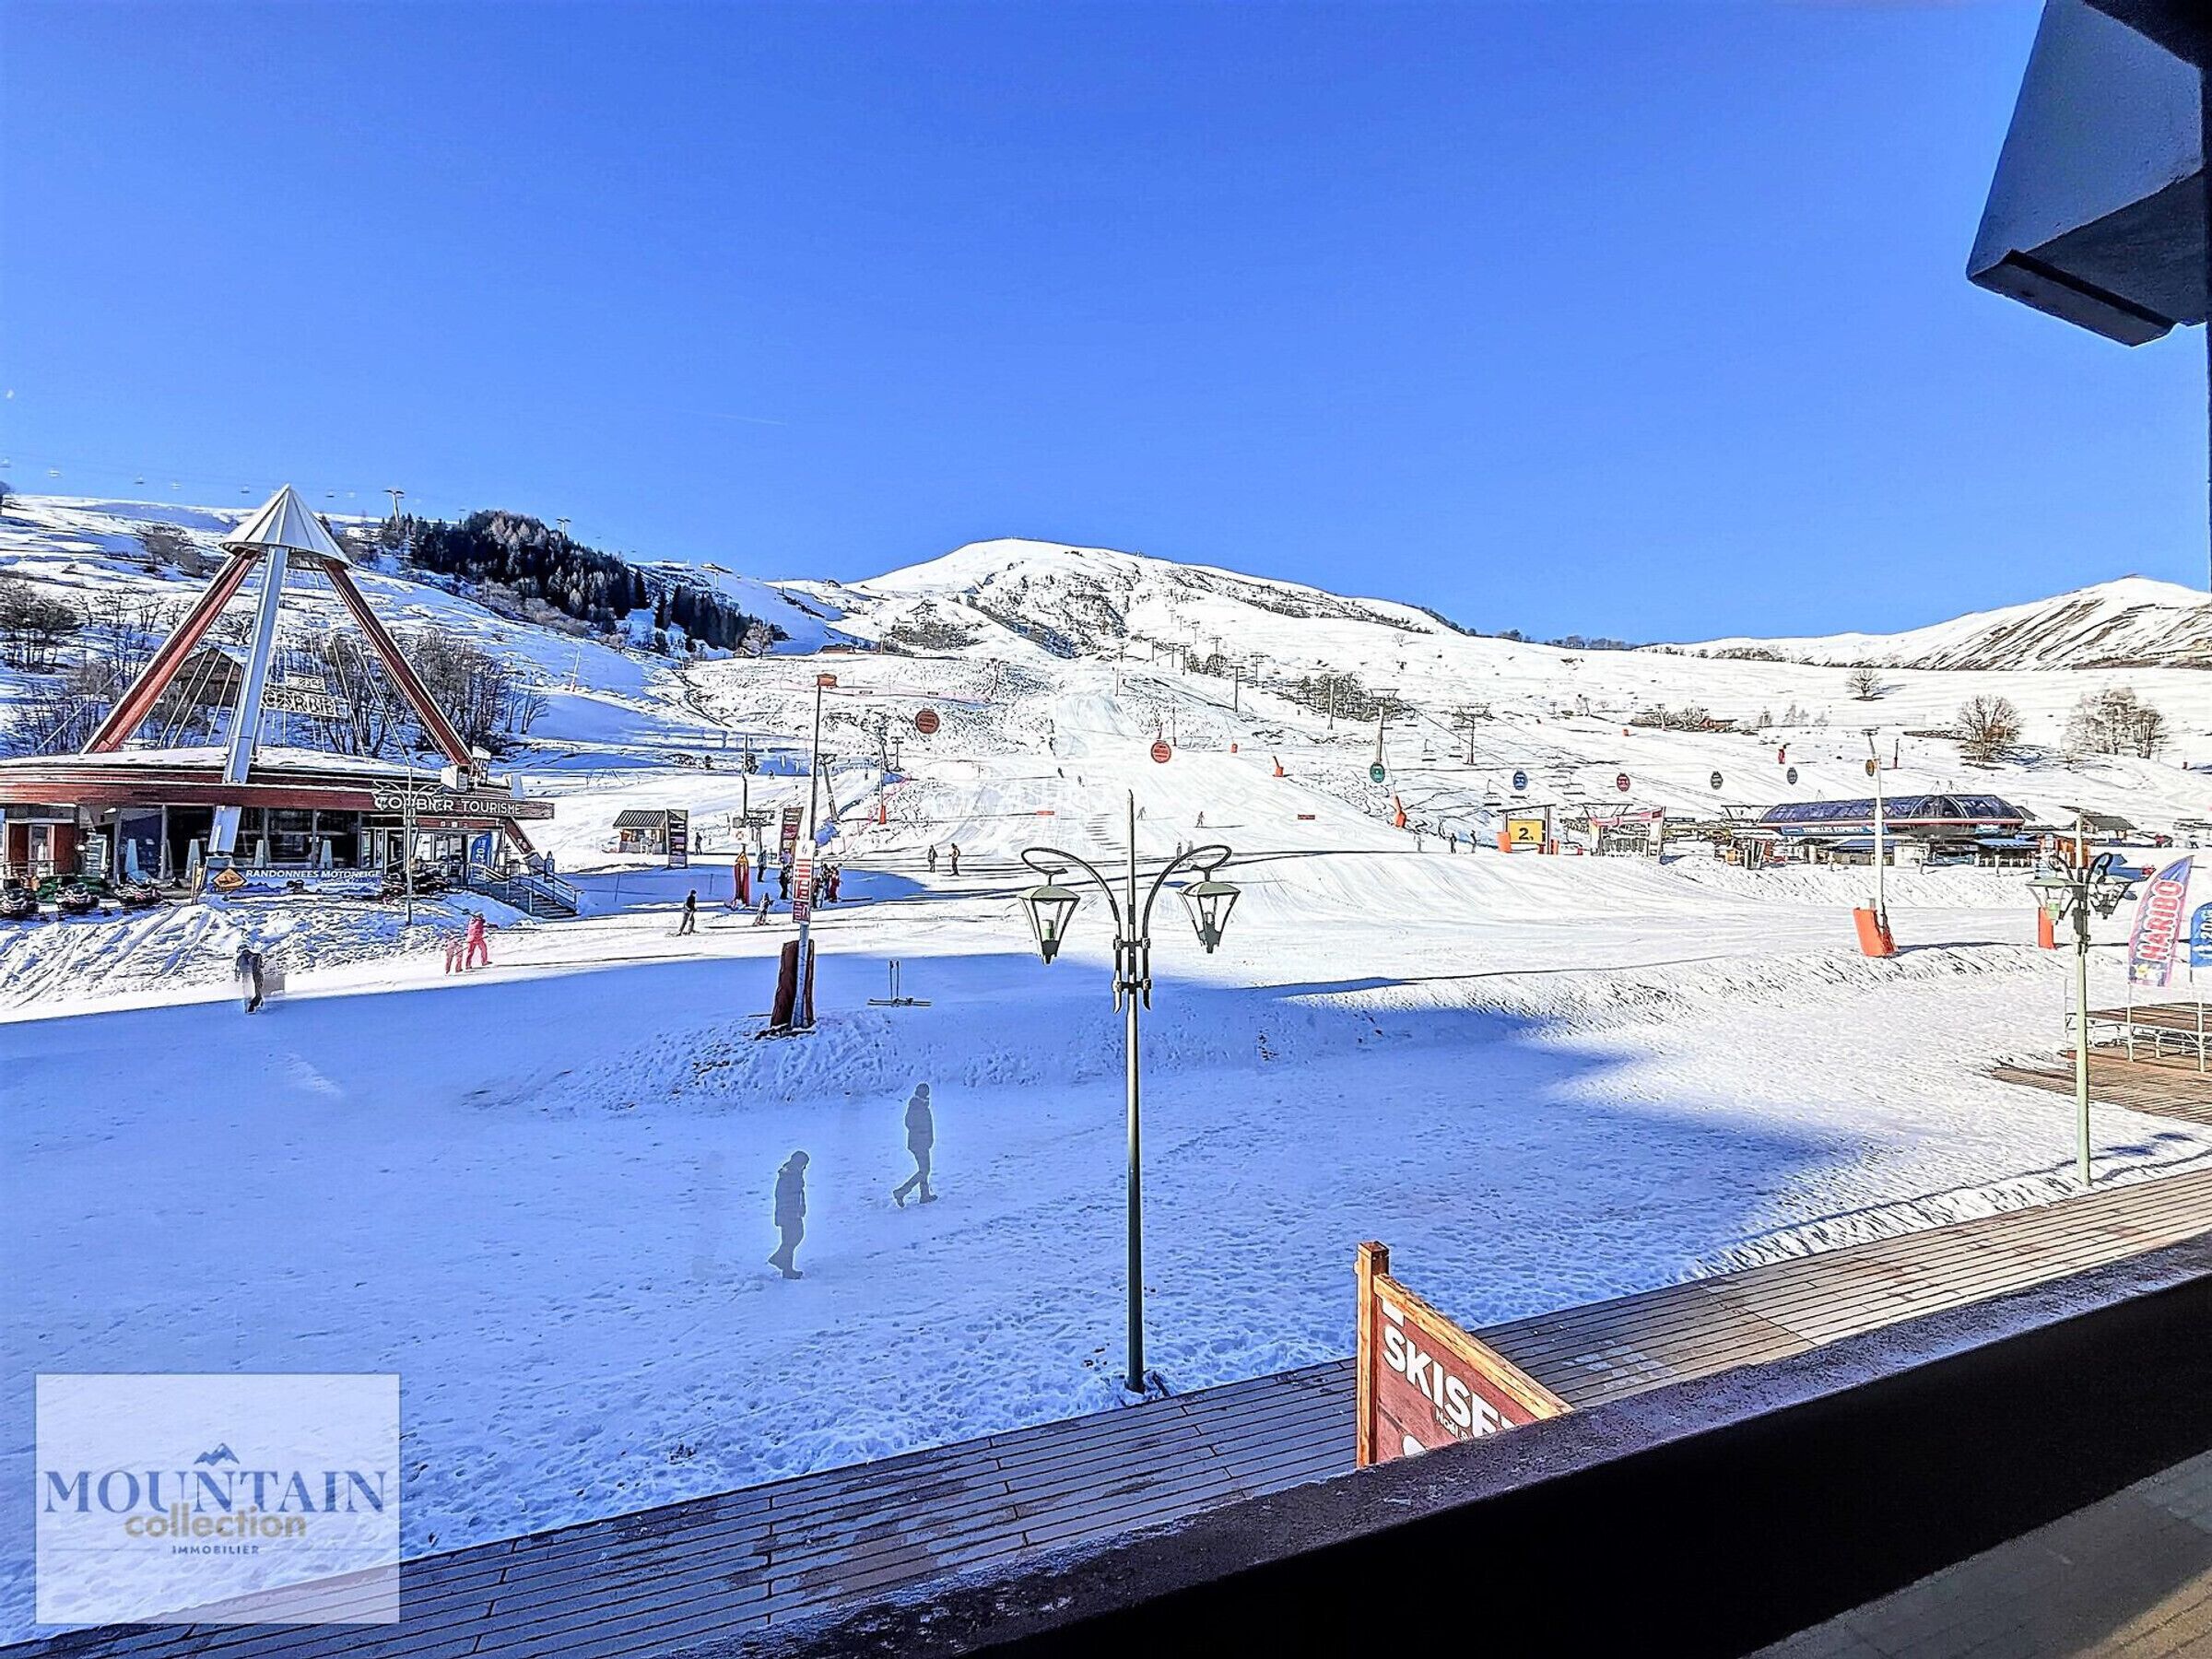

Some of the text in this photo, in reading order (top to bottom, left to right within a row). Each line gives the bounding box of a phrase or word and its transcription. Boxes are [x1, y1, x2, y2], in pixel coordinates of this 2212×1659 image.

[461, 800, 522, 815] TOURISME
[2138, 880, 2183, 962] HARIBO
[1382, 1324, 1517, 1438] SKISE
